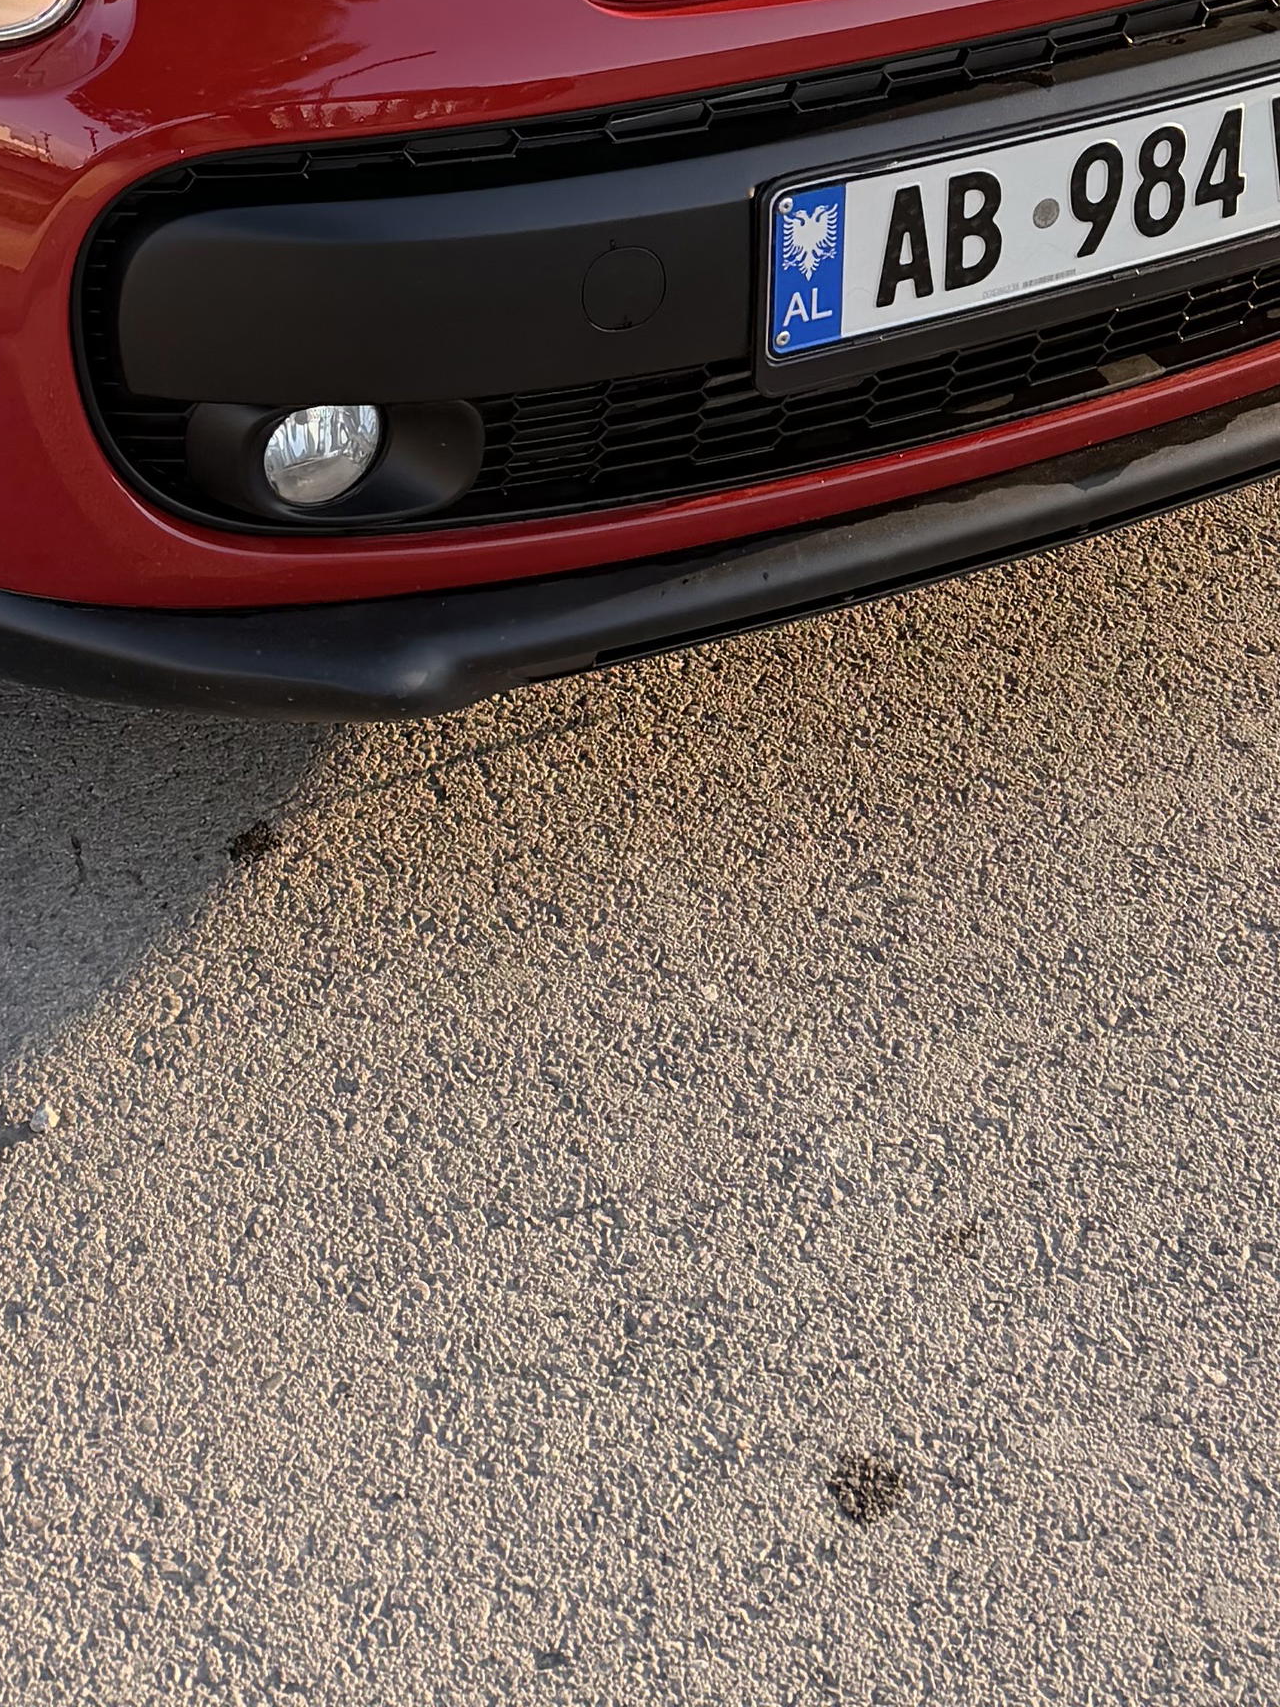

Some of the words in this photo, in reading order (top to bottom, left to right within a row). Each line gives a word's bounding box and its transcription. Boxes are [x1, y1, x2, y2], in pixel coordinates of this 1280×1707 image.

[875, 170, 1004, 308] AB
[1070, 105, 1248, 259] 984
[782, 288, 834, 327] AL
